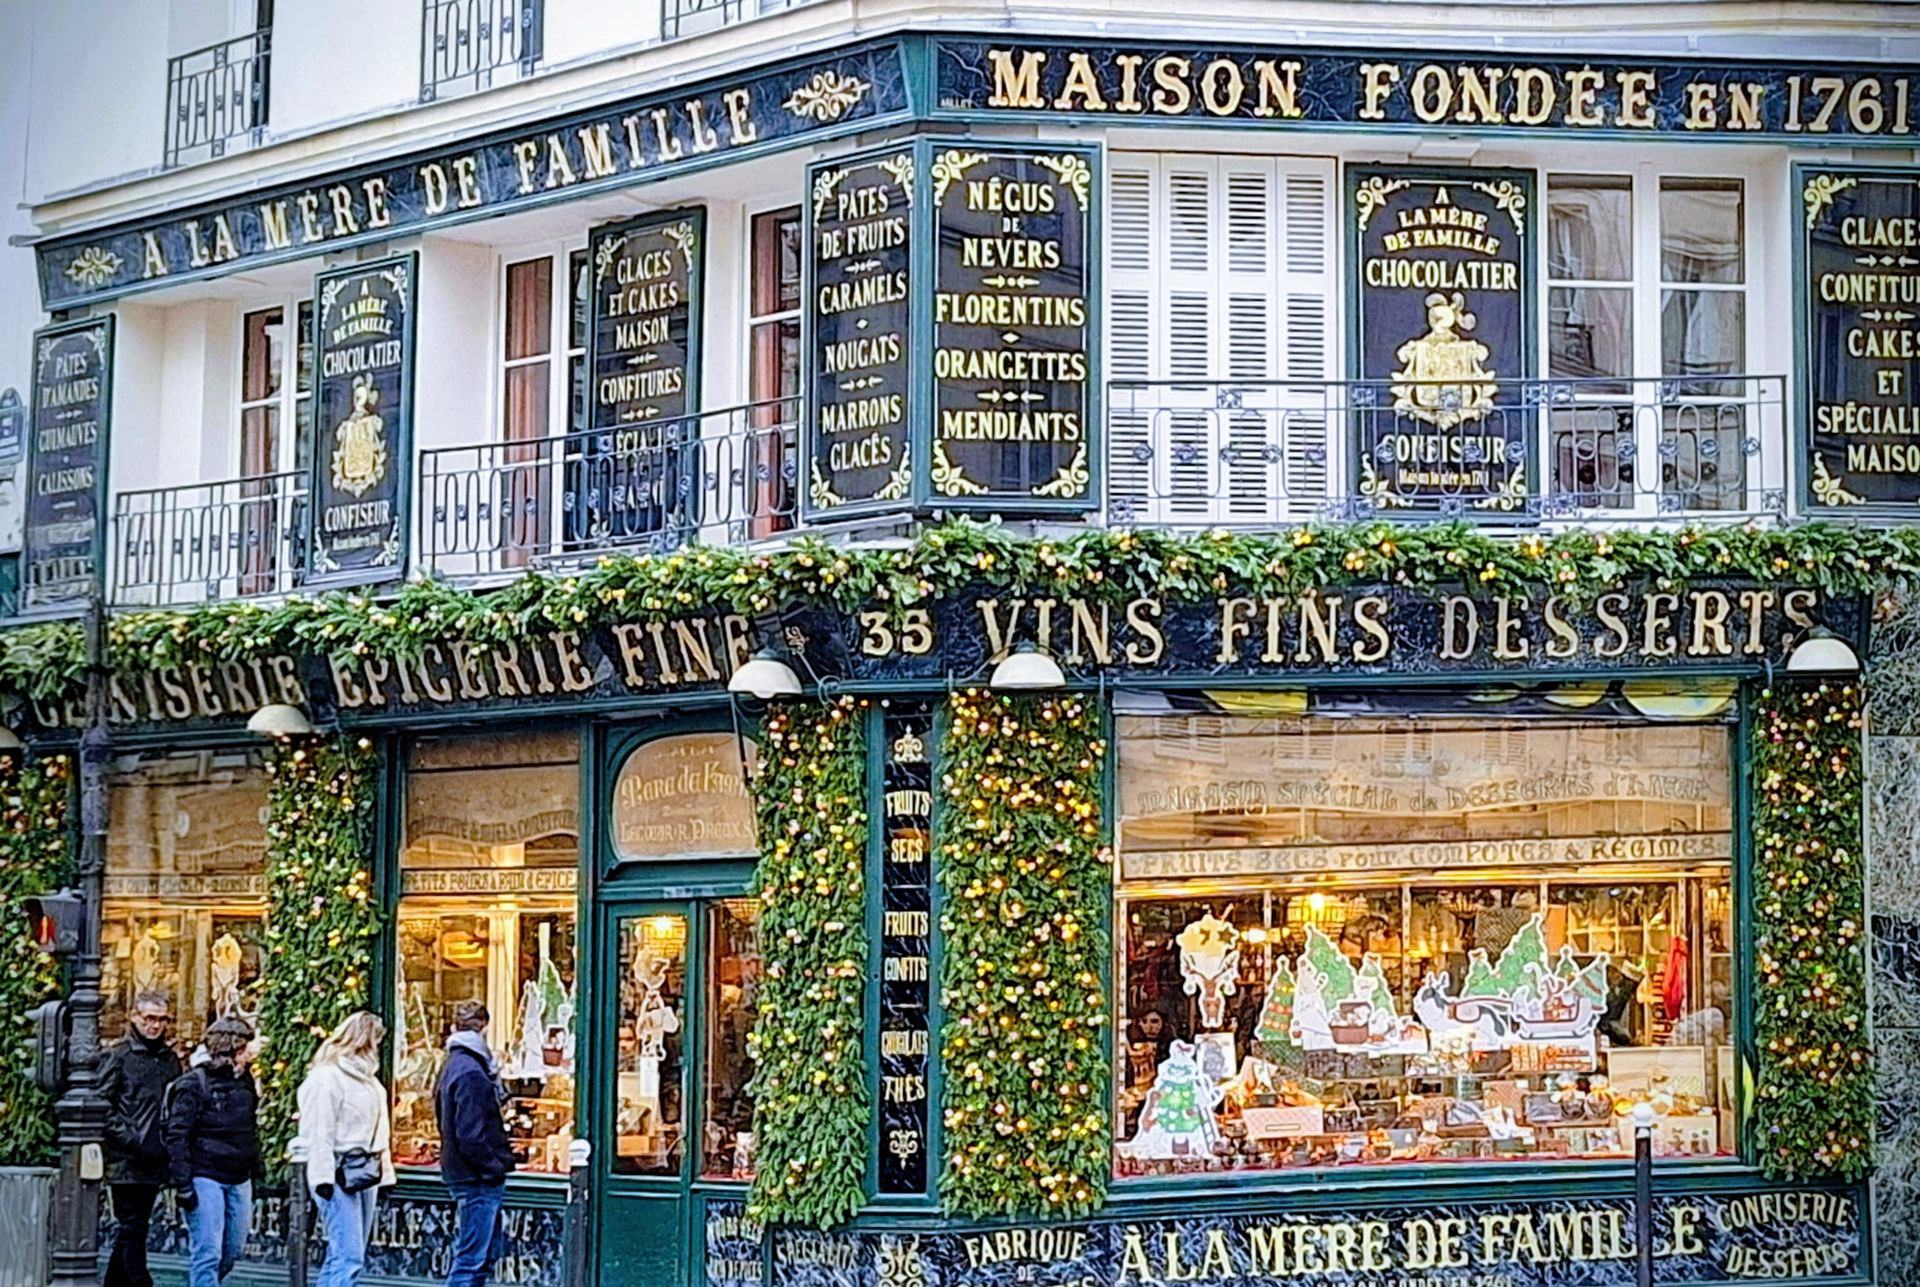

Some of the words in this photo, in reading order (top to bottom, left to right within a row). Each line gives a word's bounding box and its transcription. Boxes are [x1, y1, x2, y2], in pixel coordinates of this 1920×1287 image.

[987, 48, 1303, 118] MAISON
[1685, 82, 1763, 131] EN
[1784, 76, 1910, 134] 1761
[142, 230, 168, 279] A
[186, 214, 239, 268] LA
[420, 156, 482, 215] DE
[512, 87, 758, 194] FAMILLE
[968, 176, 1055, 212] NÉGUS
[1435, 186, 1449, 204] A
[1003, 217, 1021, 235] DE
[1398, 207, 1427, 230] LA
[1842, 216, 1920, 247] GLACE
[822, 227, 843, 260] DE
[847, 217, 905, 256] FRUITS
[963, 238, 1061, 270] NEVERS
[1383, 230, 1410, 252] DE
[1413, 228, 1500, 256] FAMILLE
[617, 250, 673, 285] GLACES
[1366, 258, 1519, 291] CHOCOLATIER
[360, 279, 369, 296] A
[609, 292, 624, 318] ET
[628, 281, 679, 314] CAKES
[819, 272, 907, 316] CARAMELS
[341, 302, 356, 321] LA
[935, 294, 1086, 327] FLORENTINS
[333, 325, 348, 345] DE
[348, 317, 394, 336] FAMILLE
[615, 316, 670, 350] MAISON
[323, 340, 401, 378] CHOCOLATIER
[825, 333, 900, 375] NOUGATS
[935, 349, 1087, 381] ORANGETTES
[600, 367, 682, 406] CONFITURES
[1878, 370, 1903, 396] ET
[822, 394, 902, 435] MARRONS
[943, 411, 1079, 442] MENDIANTS
[830, 432, 891, 472] GLACÉS
[38, 465, 93, 497] CALISSONS
[324, 499, 390, 533] CONFISEUR
[860, 608, 933, 656] 35
[976, 598, 1164, 665] VINS
[1216, 595, 1390, 663] FINS
[1440, 589, 1818, 660] DESSERTS
[612, 613, 752, 687] FINE
[886, 790, 931, 818] FRUITS
[891, 838, 923, 863] SECS
[1142, 849, 1242, 875] FRUITS
[884, 911, 929, 937] FRUITS
[884, 956, 928, 982] CONFITS
[882, 1073, 926, 1103] THÉS
[1716, 1191, 1852, 1233] CONFISERIE
[965, 1229, 1087, 1269] FABRIQUE
[1163, 1229, 1237, 1282] LA
[1401, 1218, 1470, 1270] DE
[1478, 1204, 1703, 1266] FAMILE
[1725, 1241, 1849, 1278] DESSERTS
